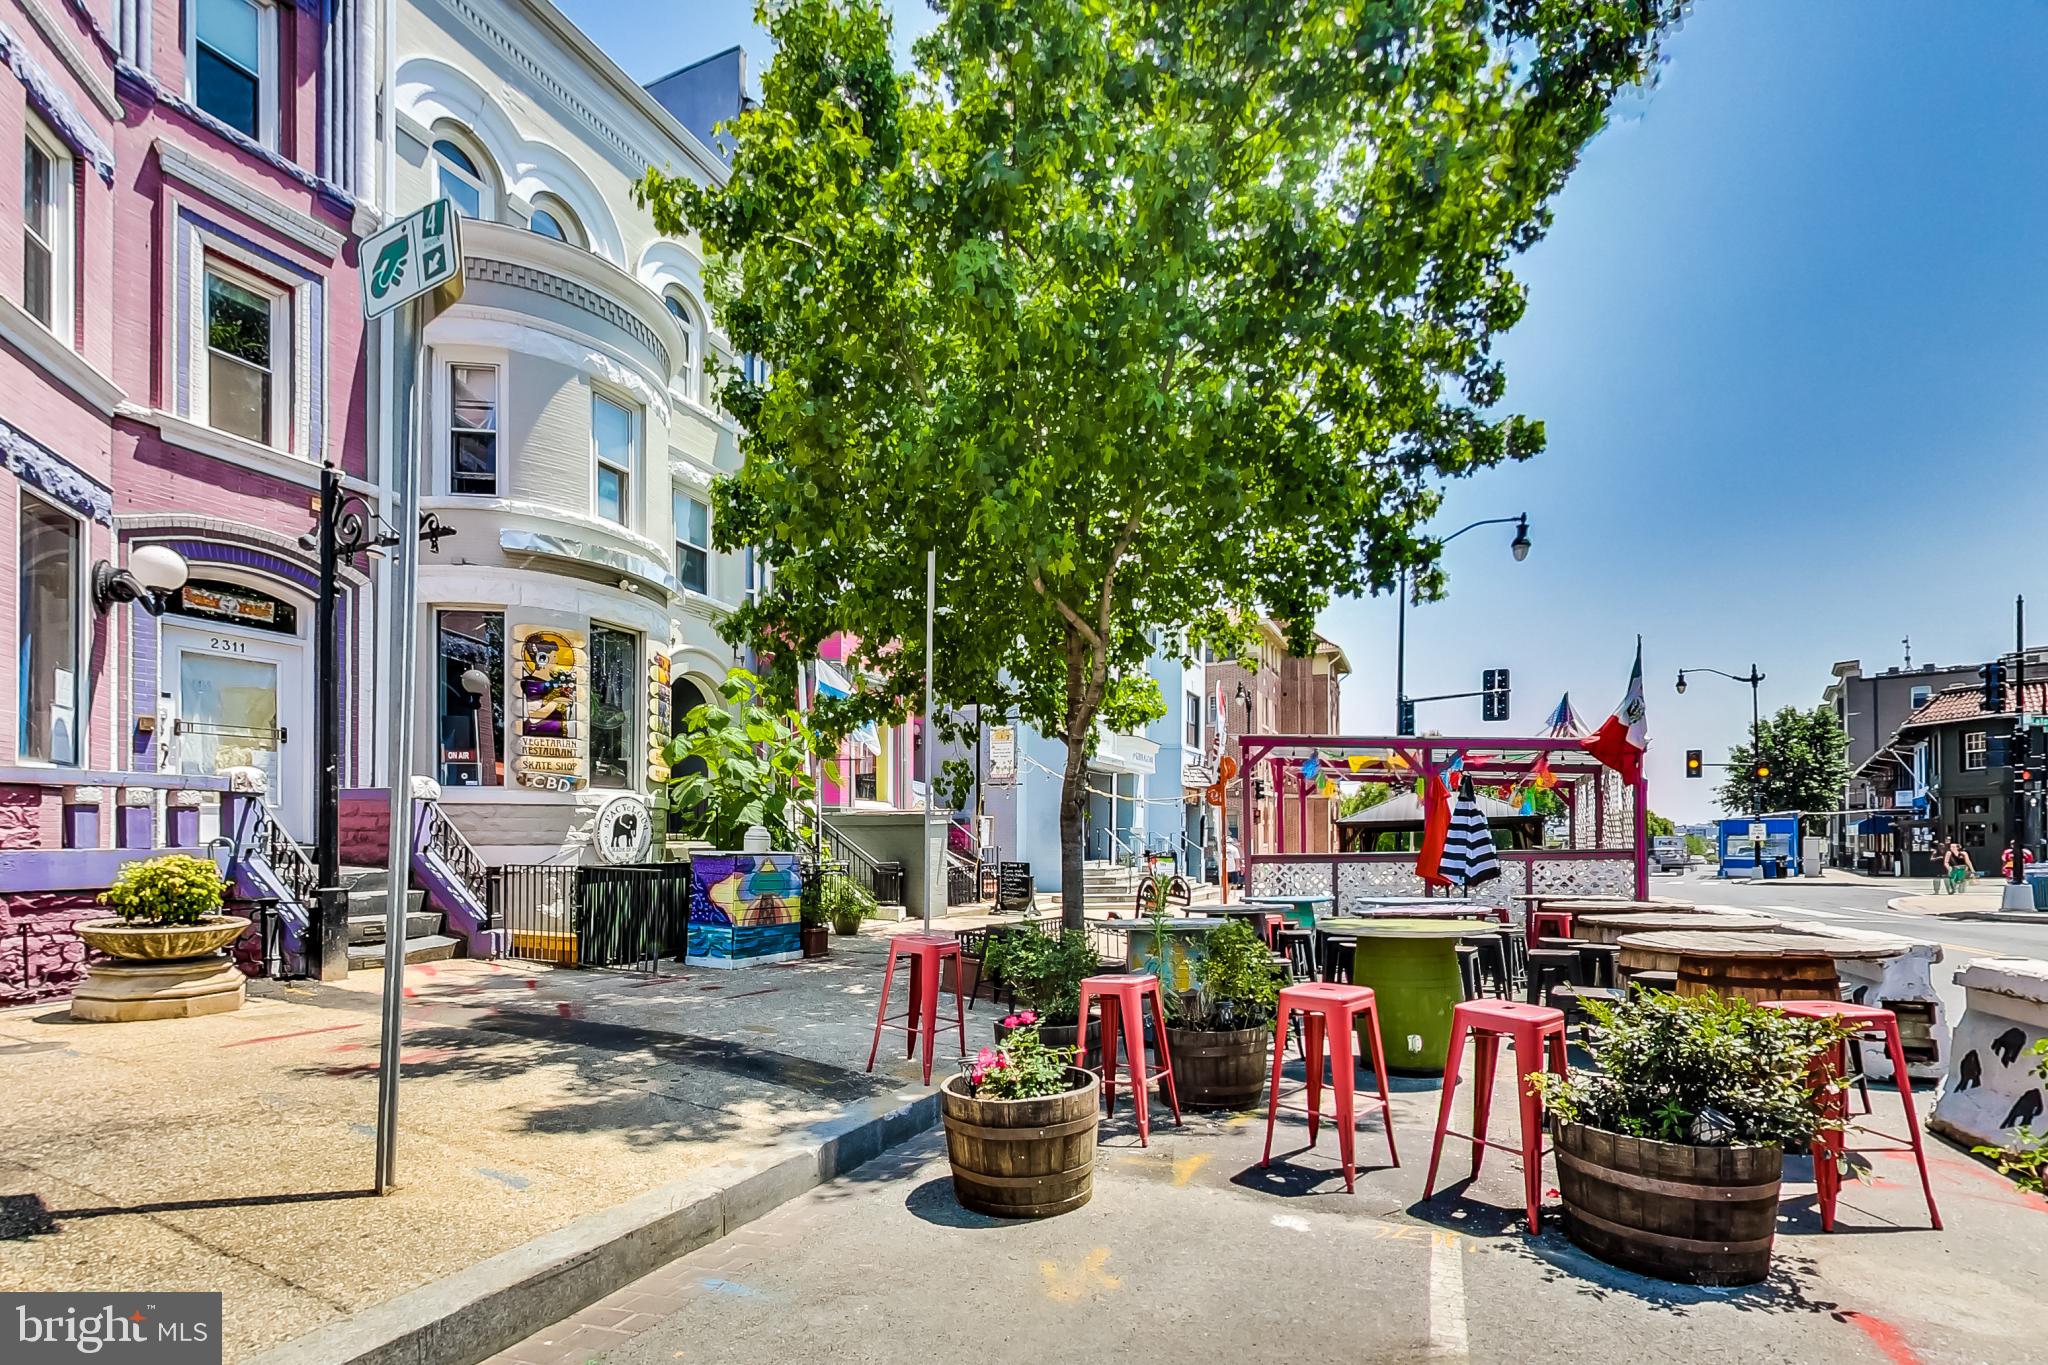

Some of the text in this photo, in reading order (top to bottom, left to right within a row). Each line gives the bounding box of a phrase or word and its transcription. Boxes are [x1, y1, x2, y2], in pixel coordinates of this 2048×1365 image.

[425, 204, 436, 235] 4
[210, 638, 245, 653] 2311
[522, 738, 577, 748] VEGETARIAN
[522, 747, 577, 757] RESTAURANT
[522, 761, 577, 771] SKATE SHOP
[532, 776, 570, 792] CBD
